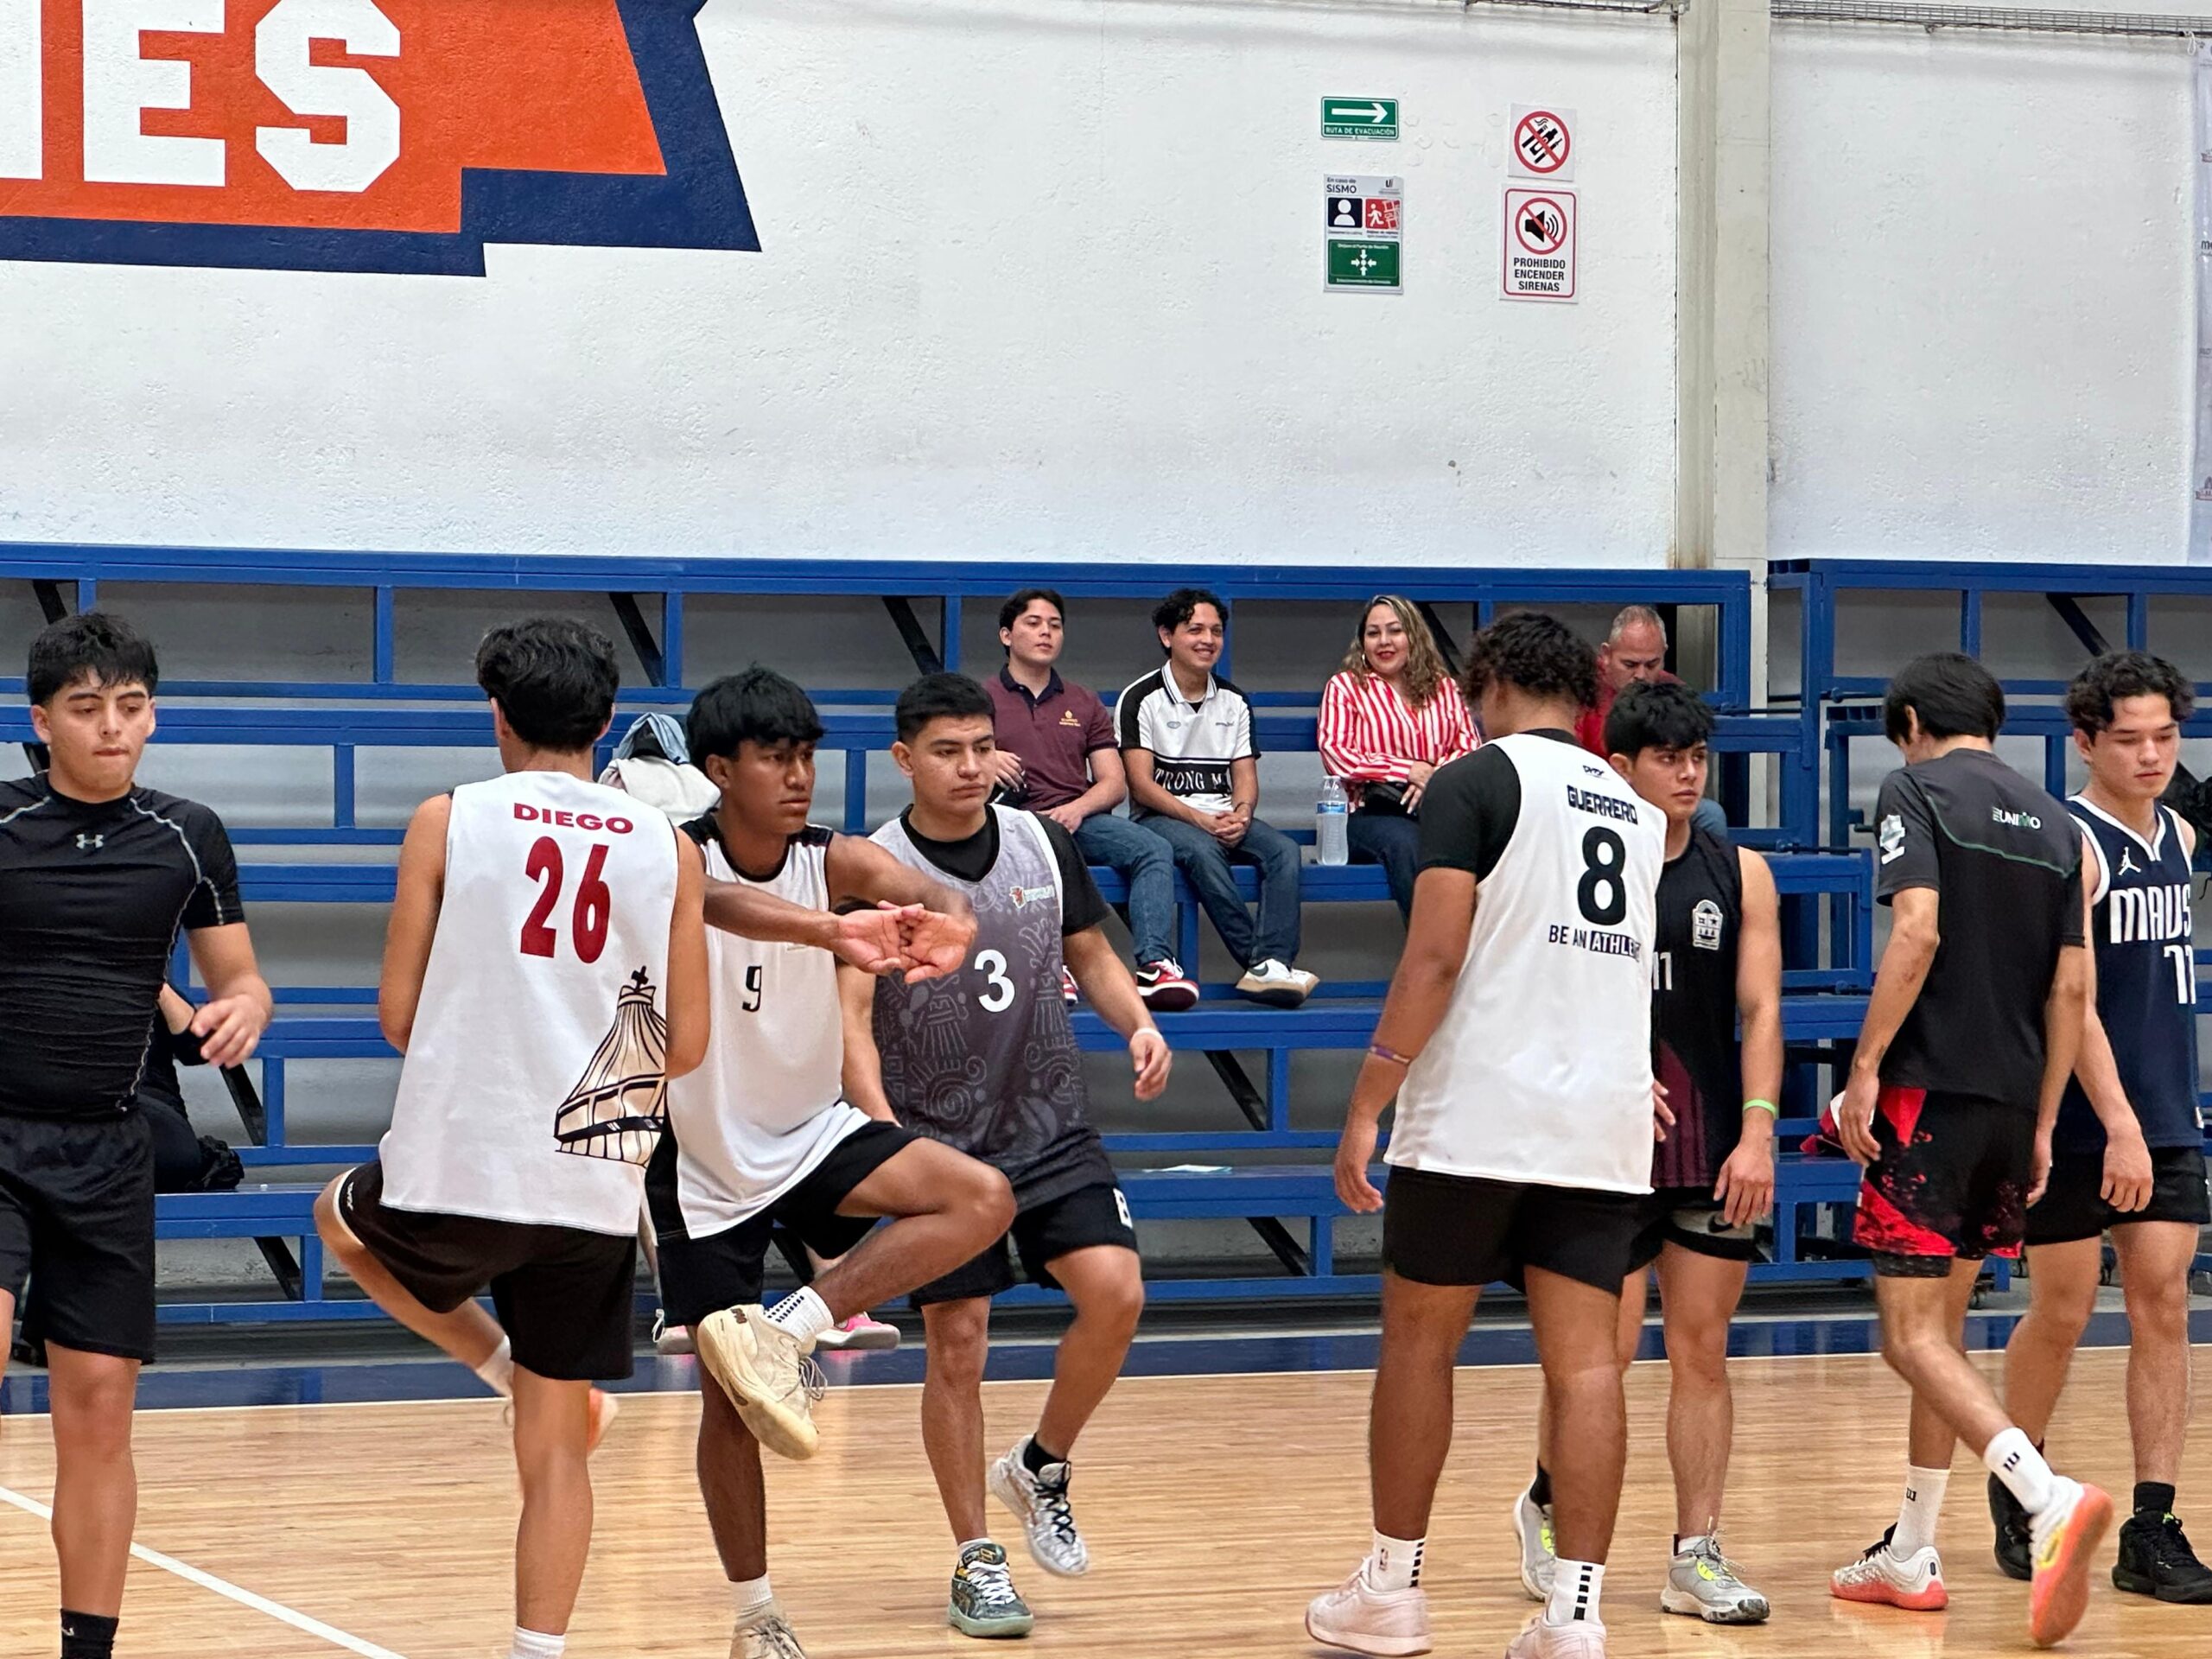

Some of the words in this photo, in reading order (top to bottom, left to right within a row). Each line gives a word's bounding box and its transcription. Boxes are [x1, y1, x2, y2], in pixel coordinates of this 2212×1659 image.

[1326, 184, 1357, 194] SISMO
[1514, 257, 1566, 269] PROHIBIDO
[1515, 269, 1565, 281] ENCENDER
[1518, 281, 1560, 292] SIRENAS
[1154, 767, 1205, 791] TRONG
[513, 803, 634, 834] DIEGO
[1567, 785, 1638, 825] GUERRERO
[1577, 826, 1626, 926] 8
[520, 836, 611, 964] 26
[1548, 925, 1569, 944] BE
[1572, 928, 1587, 949] AN
[742, 965, 762, 1013] 9
[974, 949, 1015, 1013] 3
